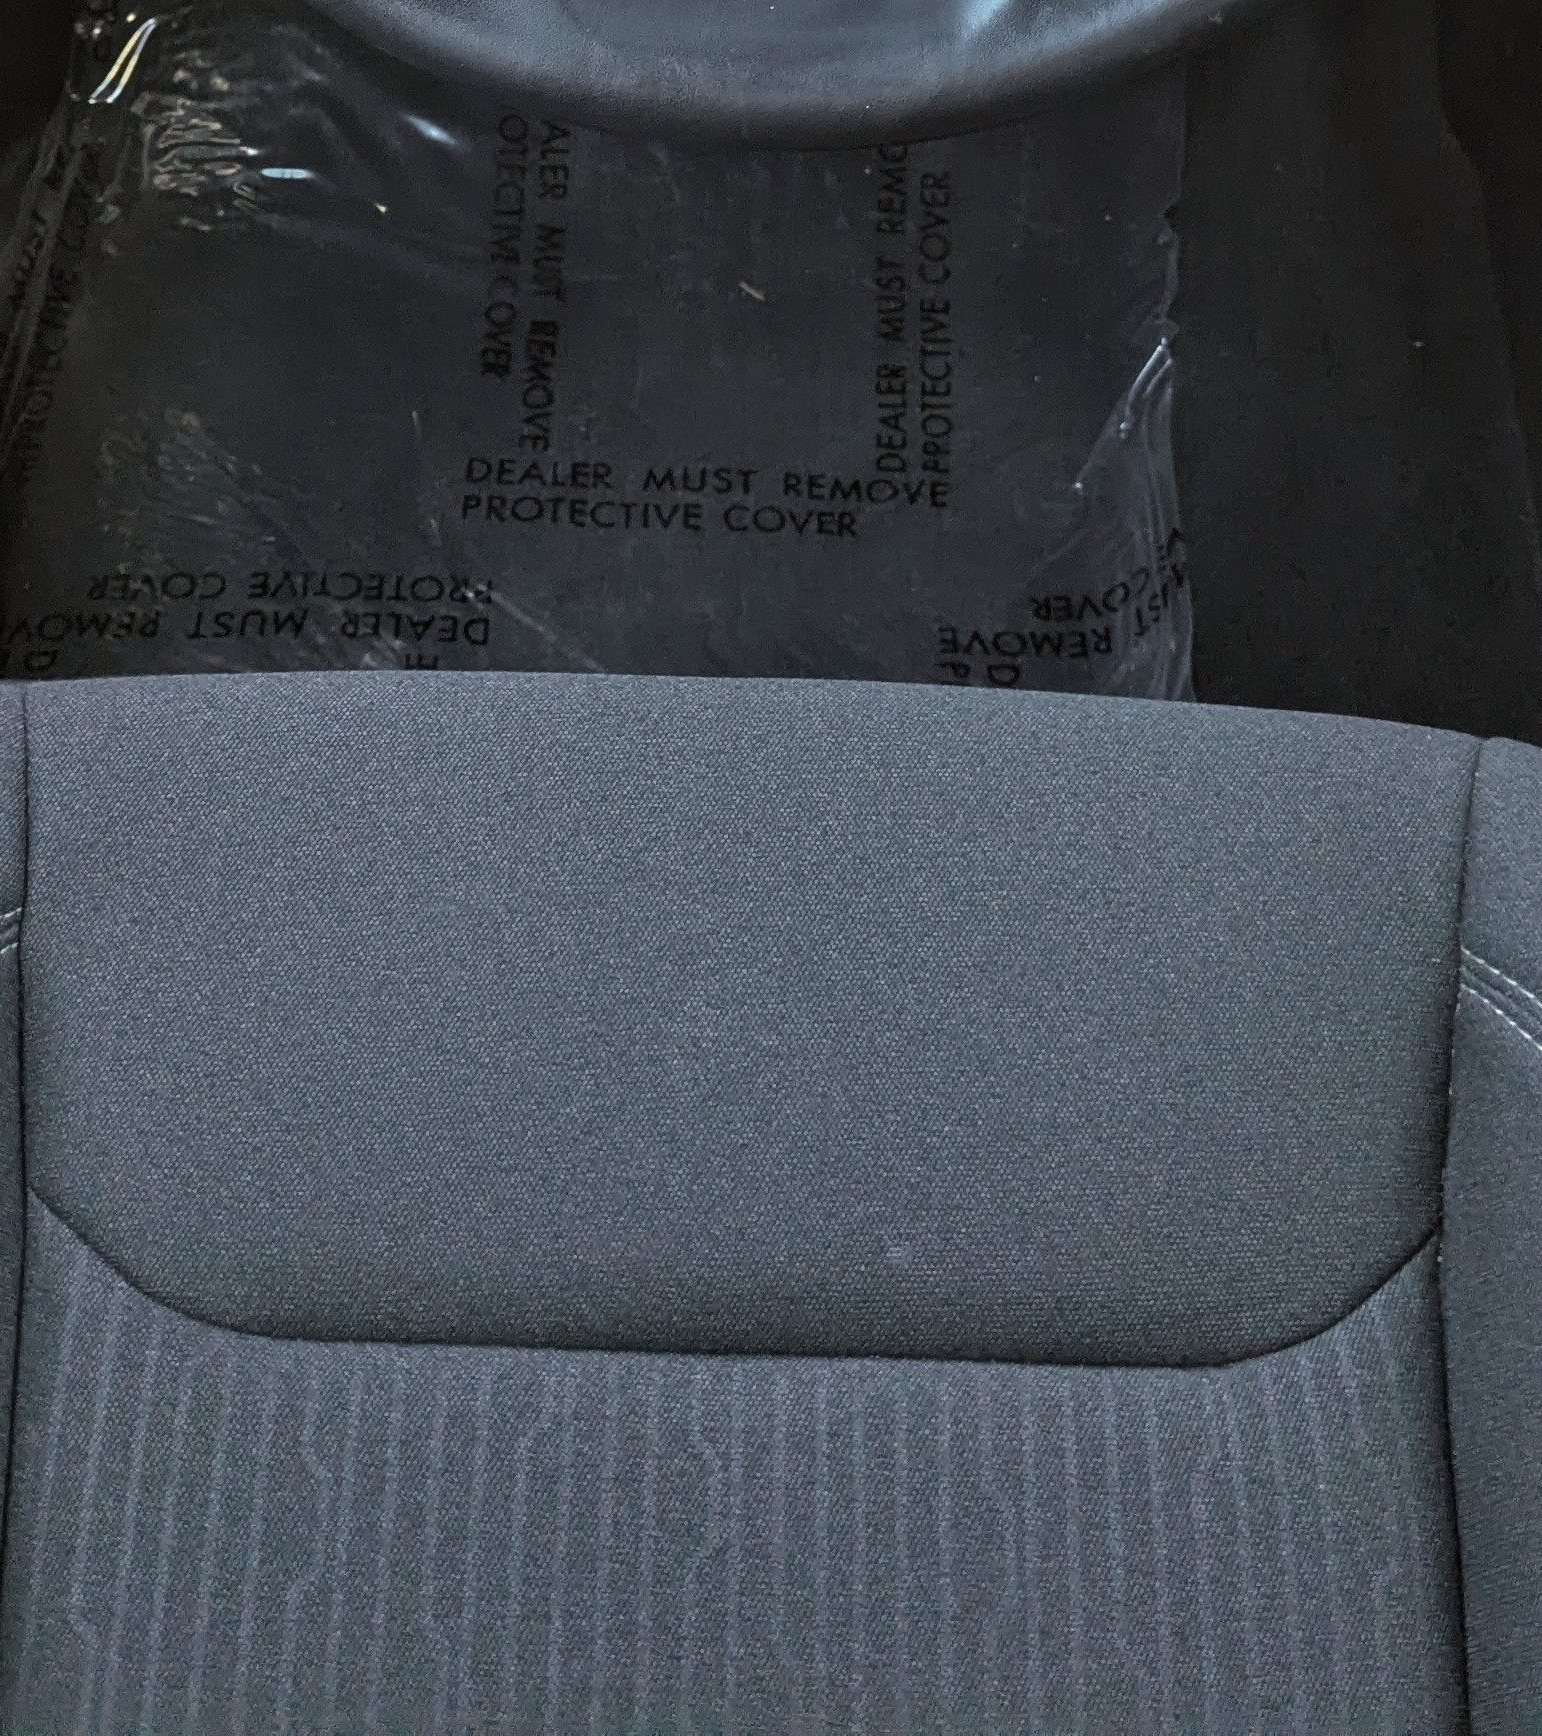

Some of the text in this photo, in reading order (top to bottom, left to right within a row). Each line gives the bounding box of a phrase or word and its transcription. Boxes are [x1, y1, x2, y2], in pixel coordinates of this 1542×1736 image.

[538, 119, 570, 201] ALER
[480, 108, 531, 379] OTECTIVE COVER
[917, 171, 954, 475] PROTECTIVE COVER
[519, 319, 560, 454] REMOVE
[874, 254, 908, 475] DEALER MUST
[461, 494, 858, 538] PROTECTIVE COVER
[465, 457, 950, 509] DEALER MUST REMOVE
[87, 571, 229, 604] COVER
[186, 609, 490, 648] DEALER MUST
[938, 625, 1113, 659] REMOVE
